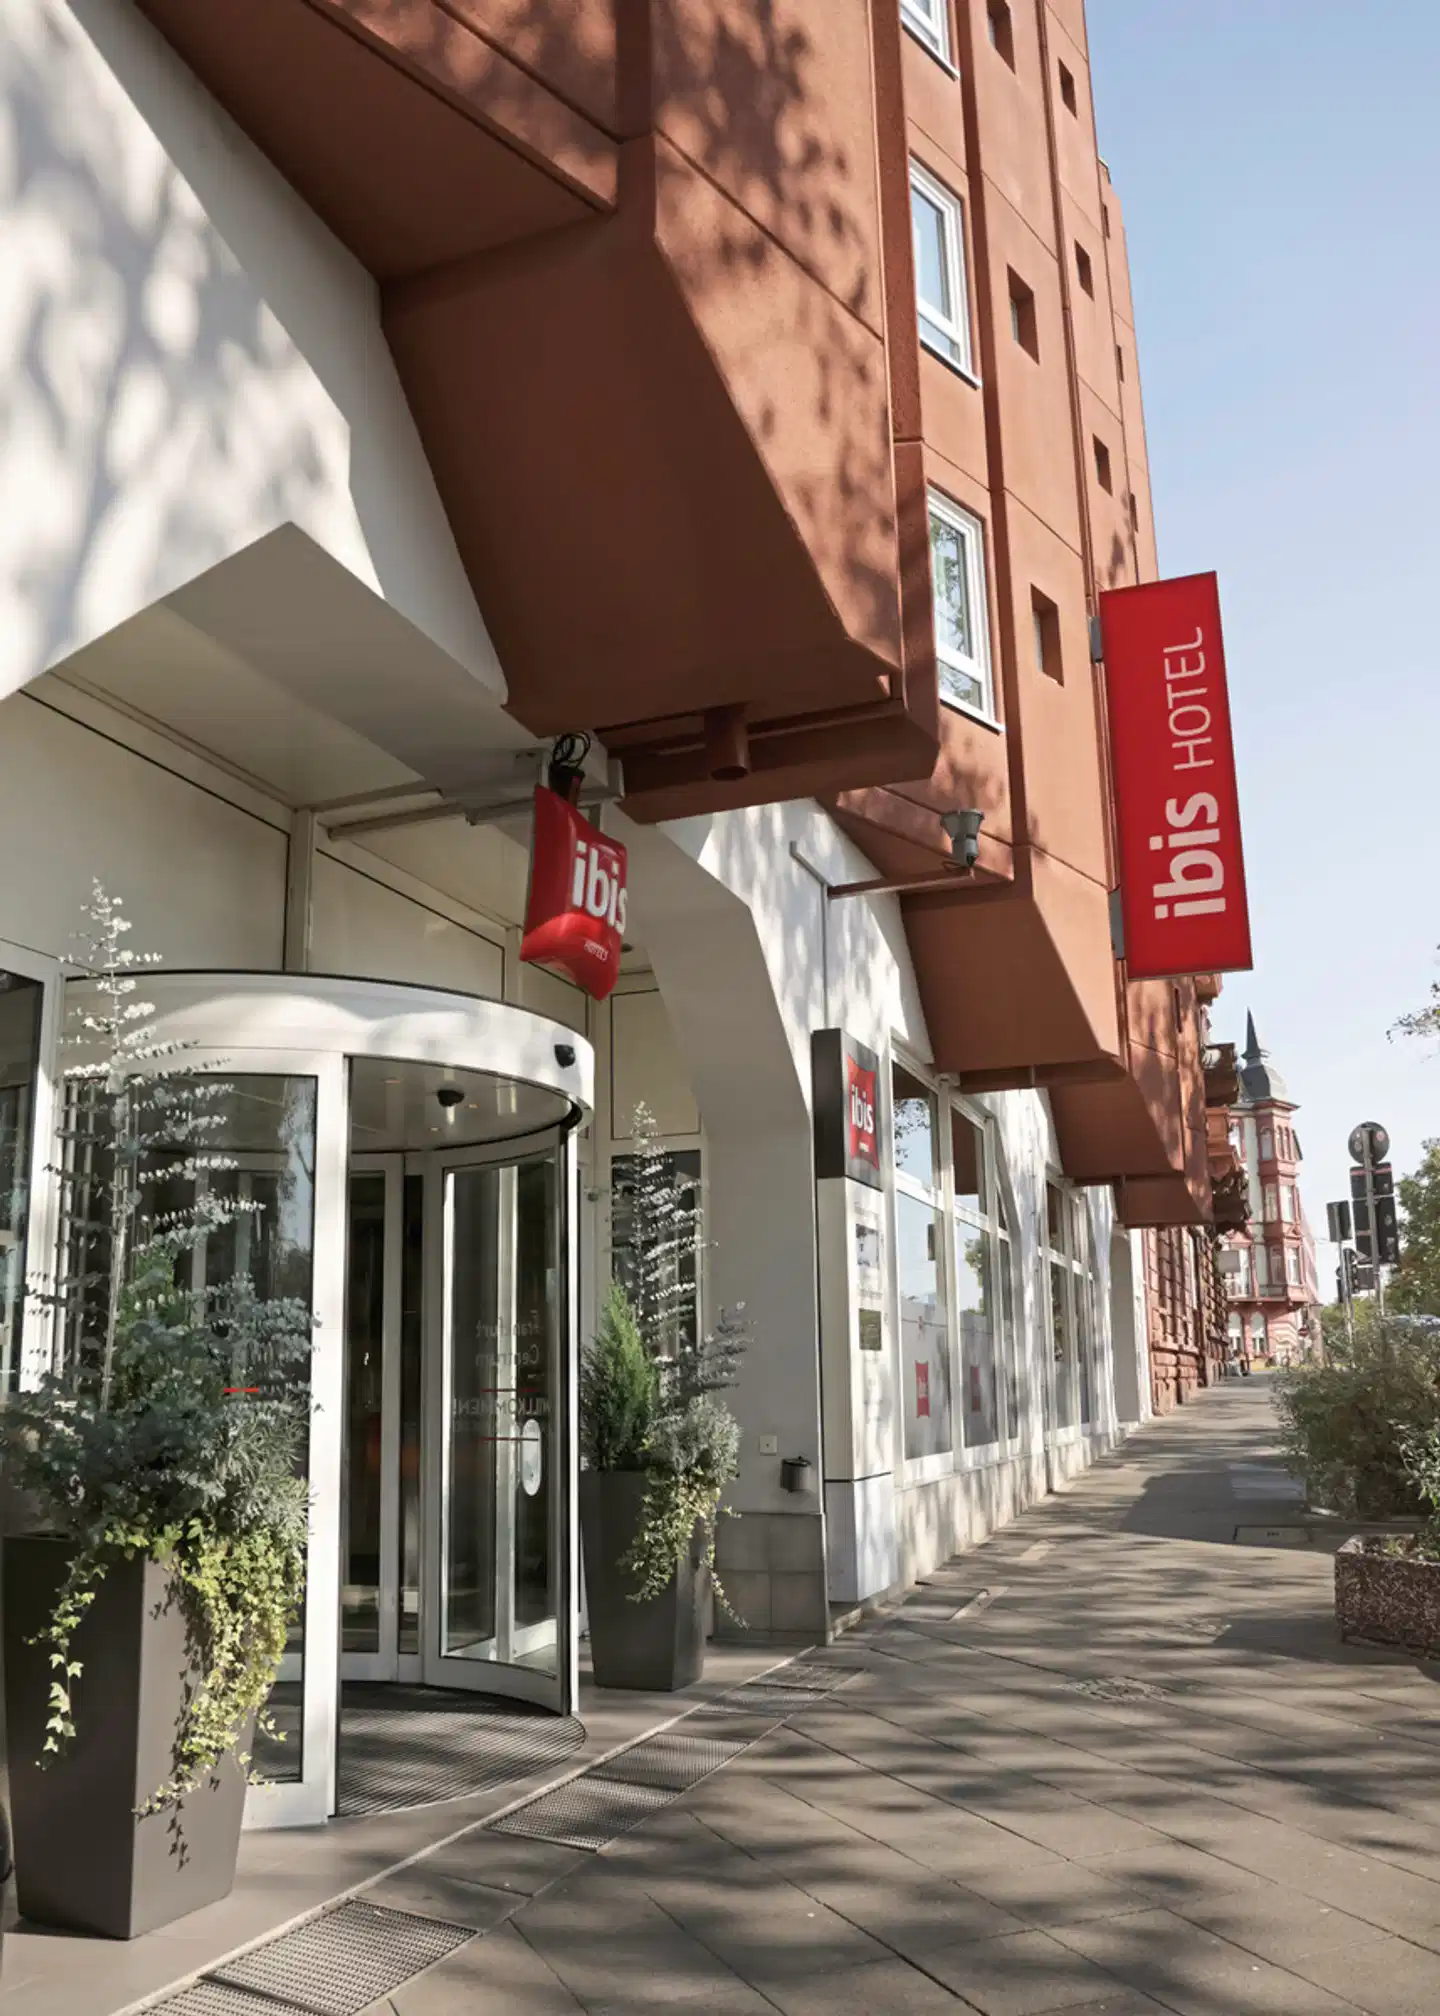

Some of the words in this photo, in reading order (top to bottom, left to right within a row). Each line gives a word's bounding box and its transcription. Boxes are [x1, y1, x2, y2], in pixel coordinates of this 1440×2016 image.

[1162, 626, 1215, 771] HOTEL
[571, 839, 628, 936] ibis
[1148, 790, 1227, 920] ibis
[851, 1083, 874, 1134] ibis
